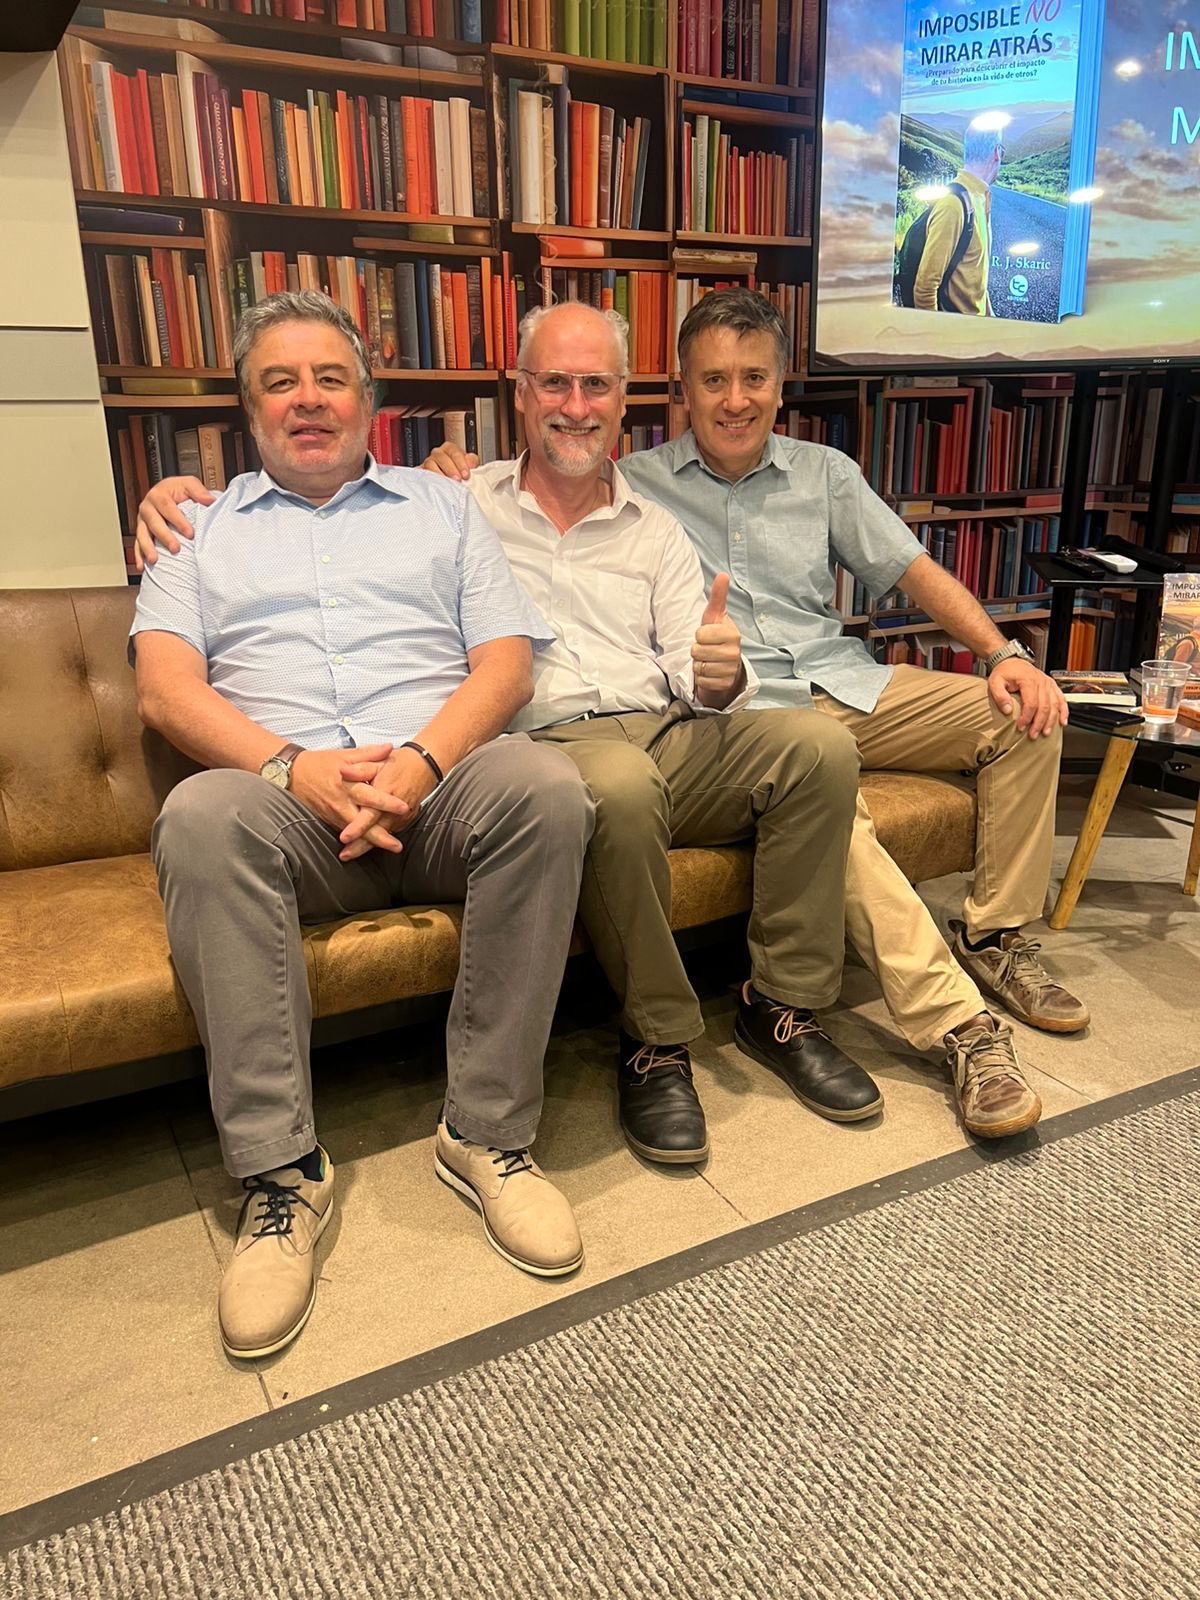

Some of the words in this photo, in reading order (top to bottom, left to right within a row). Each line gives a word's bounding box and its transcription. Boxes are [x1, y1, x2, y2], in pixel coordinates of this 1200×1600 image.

[919, 6, 1020, 38] IMPOSIBLE
[1025, 0, 1061, 24] NO
[921, 40, 983, 66] MIRAR
[988, 28, 1053, 58] ATRÁS
[925, 66, 960, 78] ¿Preparado
[960, 66, 975, 75] para
[976, 63, 1008, 72] descubrir
[1017, 59, 1046, 69] impacto
[947, 75, 972, 84] historia
[983, 73, 989, 81] la
[990, 72, 1004, 80] vida
[1005, 71, 1014, 79] de
[1015, 69, 1038, 78] otros?
[991, 256, 1003, 267] R.
[1005, 256, 1013, 270] J.
[1015, 256, 1051, 270] Skaric
